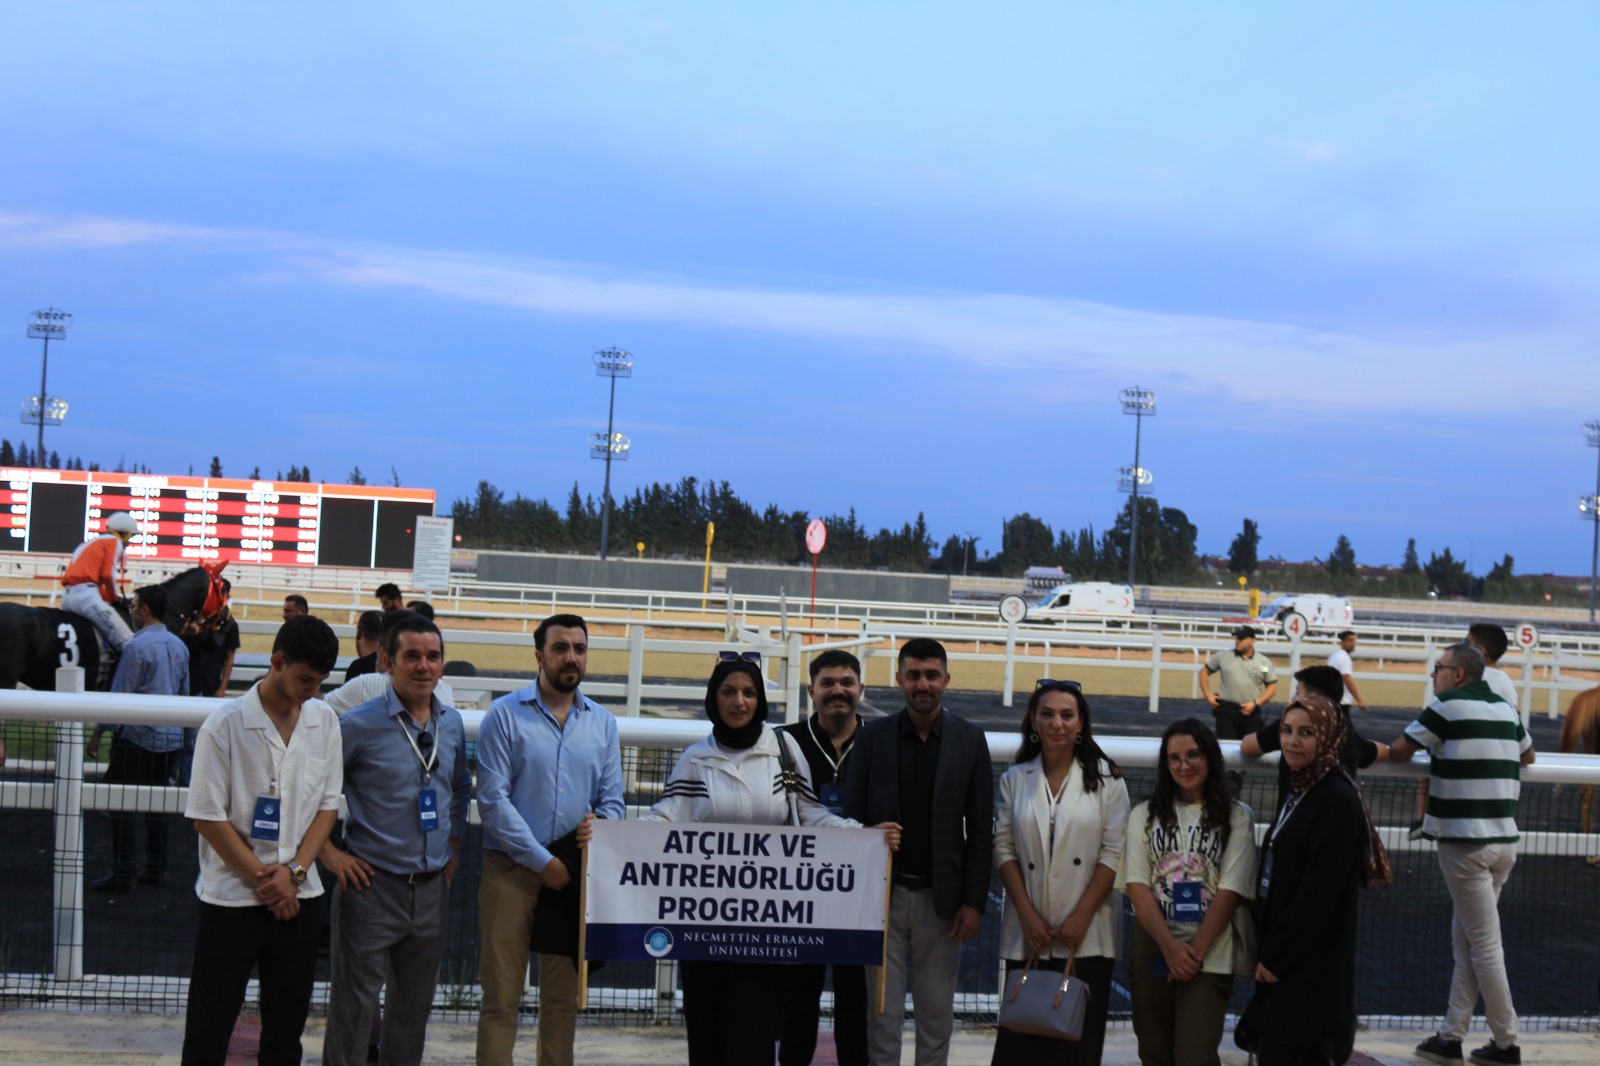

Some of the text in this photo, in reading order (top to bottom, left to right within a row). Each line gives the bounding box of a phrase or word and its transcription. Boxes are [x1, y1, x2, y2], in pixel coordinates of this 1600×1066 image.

[1006, 600, 1020, 618] 3
[1289, 617, 1300, 634] 4
[57, 622, 80, 667] 3
[1520, 627, 1534, 644] 5
[662, 829, 817, 860] ATÇILIK VE
[619, 860, 855, 893] ANTRENÖRLÜĞÜ
[657, 895, 814, 925] PROGRAMI
[683, 930, 825, 946] NECMETTİN ERBAKAN
[709, 944, 798, 958] ÜNİVERSİTESİ
